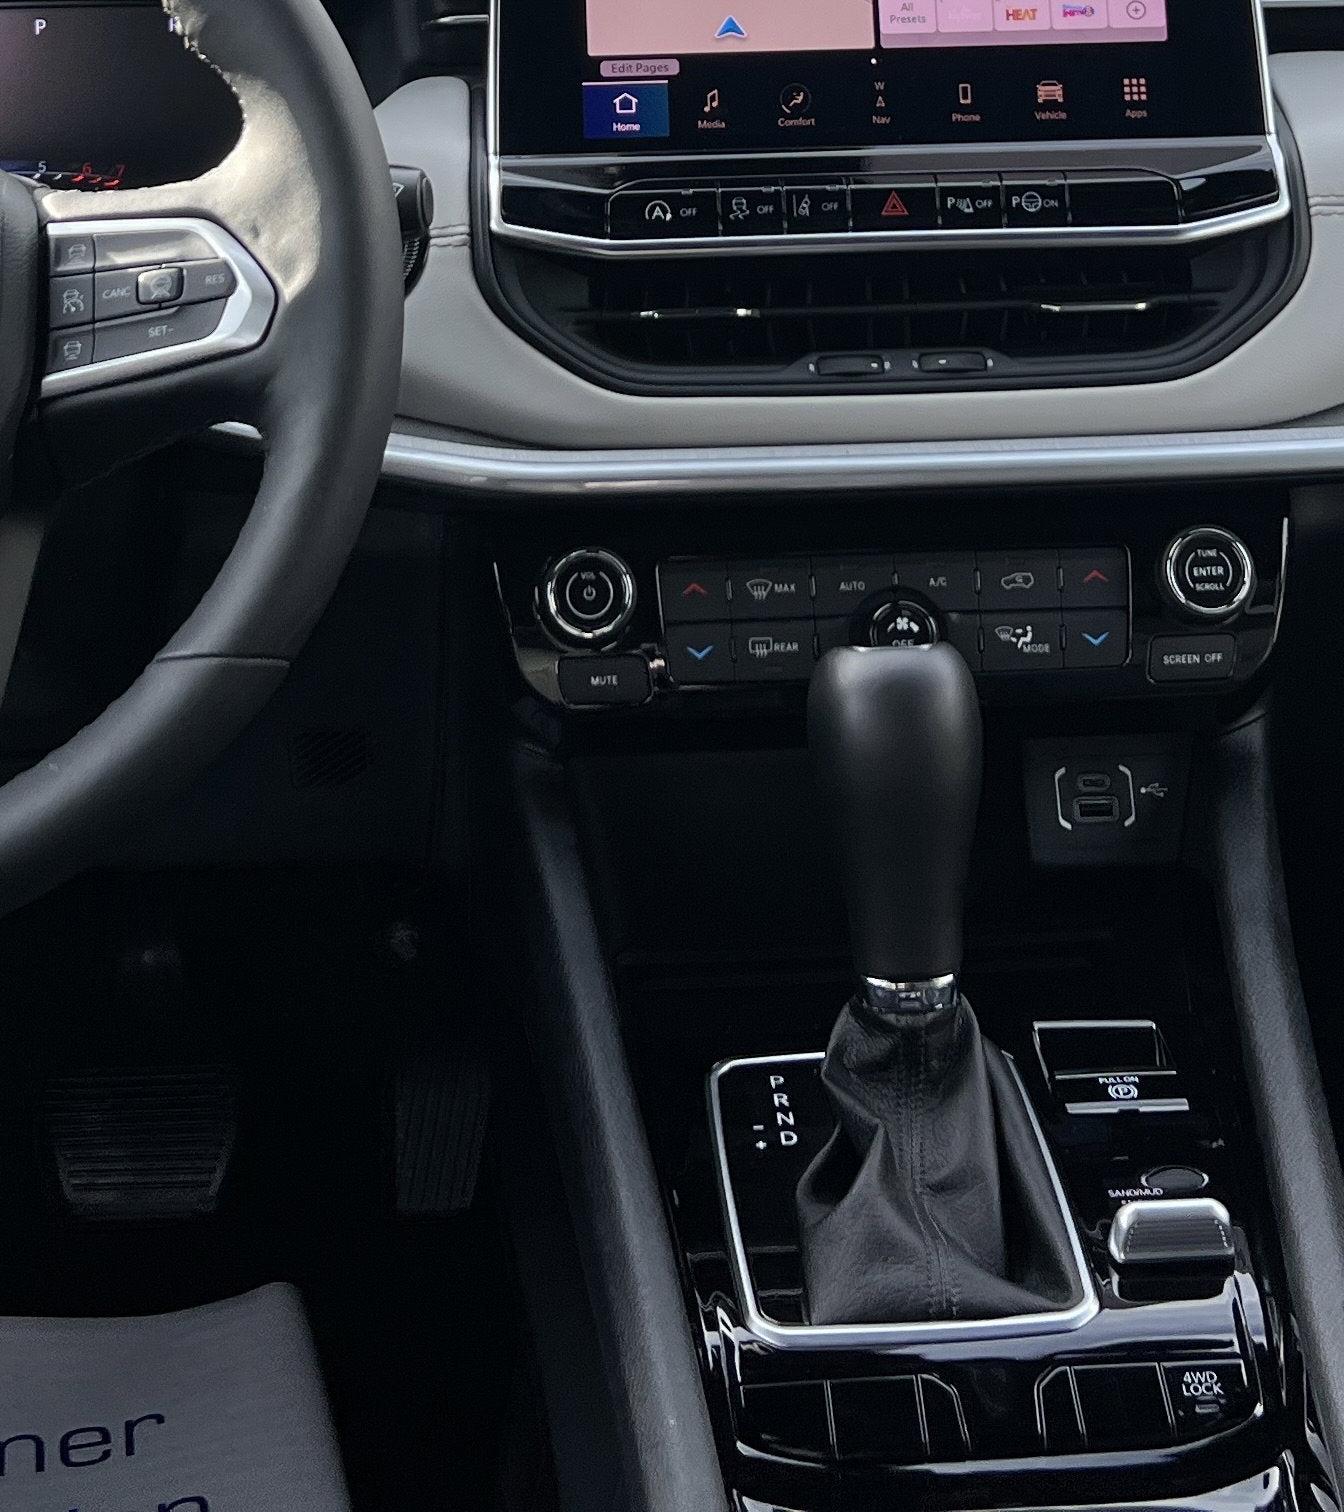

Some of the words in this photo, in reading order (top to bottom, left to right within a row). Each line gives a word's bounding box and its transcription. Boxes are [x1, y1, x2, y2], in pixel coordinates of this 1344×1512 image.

[900, 2, 914, 12] All
[889, 14, 927, 25] Presets
[1005, 8, 1038, 21] HEAT
[34, 19, 47, 35] P
[611, 62, 634, 74] Edit
[635, 62, 670, 74] Pages
[874, 81, 885, 91] W
[872, 115, 891, 125] Nav
[952, 112, 981, 123] Phone
[1034, 109, 1068, 121] Vehicle
[1124, 109, 1149, 120] Apps
[612, 121, 641, 133] Home
[697, 120, 726, 130] Media
[777, 116, 816, 128] Comfort
[38, 160, 47, 174] 5
[82, 162, 93, 175] 6
[756, 205, 775, 214] OFF
[821, 202, 839, 212] OFF
[975, 199, 993, 209] OFF
[1043, 199, 1058, 208] ON
[679, 207, 698, 217] OFF
[204, 274, 225, 284] RES
[102, 287, 132, 299] CANC
[1196, 548, 1218, 559] TUNE
[1193, 565, 1225, 578] ENTER
[839, 580, 866, 592] AUTO
[928, 577, 947, 587] A/C
[1194, 581, 1226, 591] SCROLL
[774, 583, 796, 594] MAX
[774, 641, 799, 653] REAR
[1022, 643, 1051, 654] MODE
[1163, 653, 1201, 665] SCREEN
[1204, 652, 1224, 663] OFF
[590, 675, 619, 687] MUTE
[769, 1075, 785, 1089] P
[1123, 1075, 1140, 1084] ON
[773, 1093, 790, 1108] R
[776, 1111, 795, 1127] N
[779, 1130, 798, 1147] D
[1183, 1370, 1218, 1384] 4WD
[1181, 1383, 1224, 1396] LOCK
